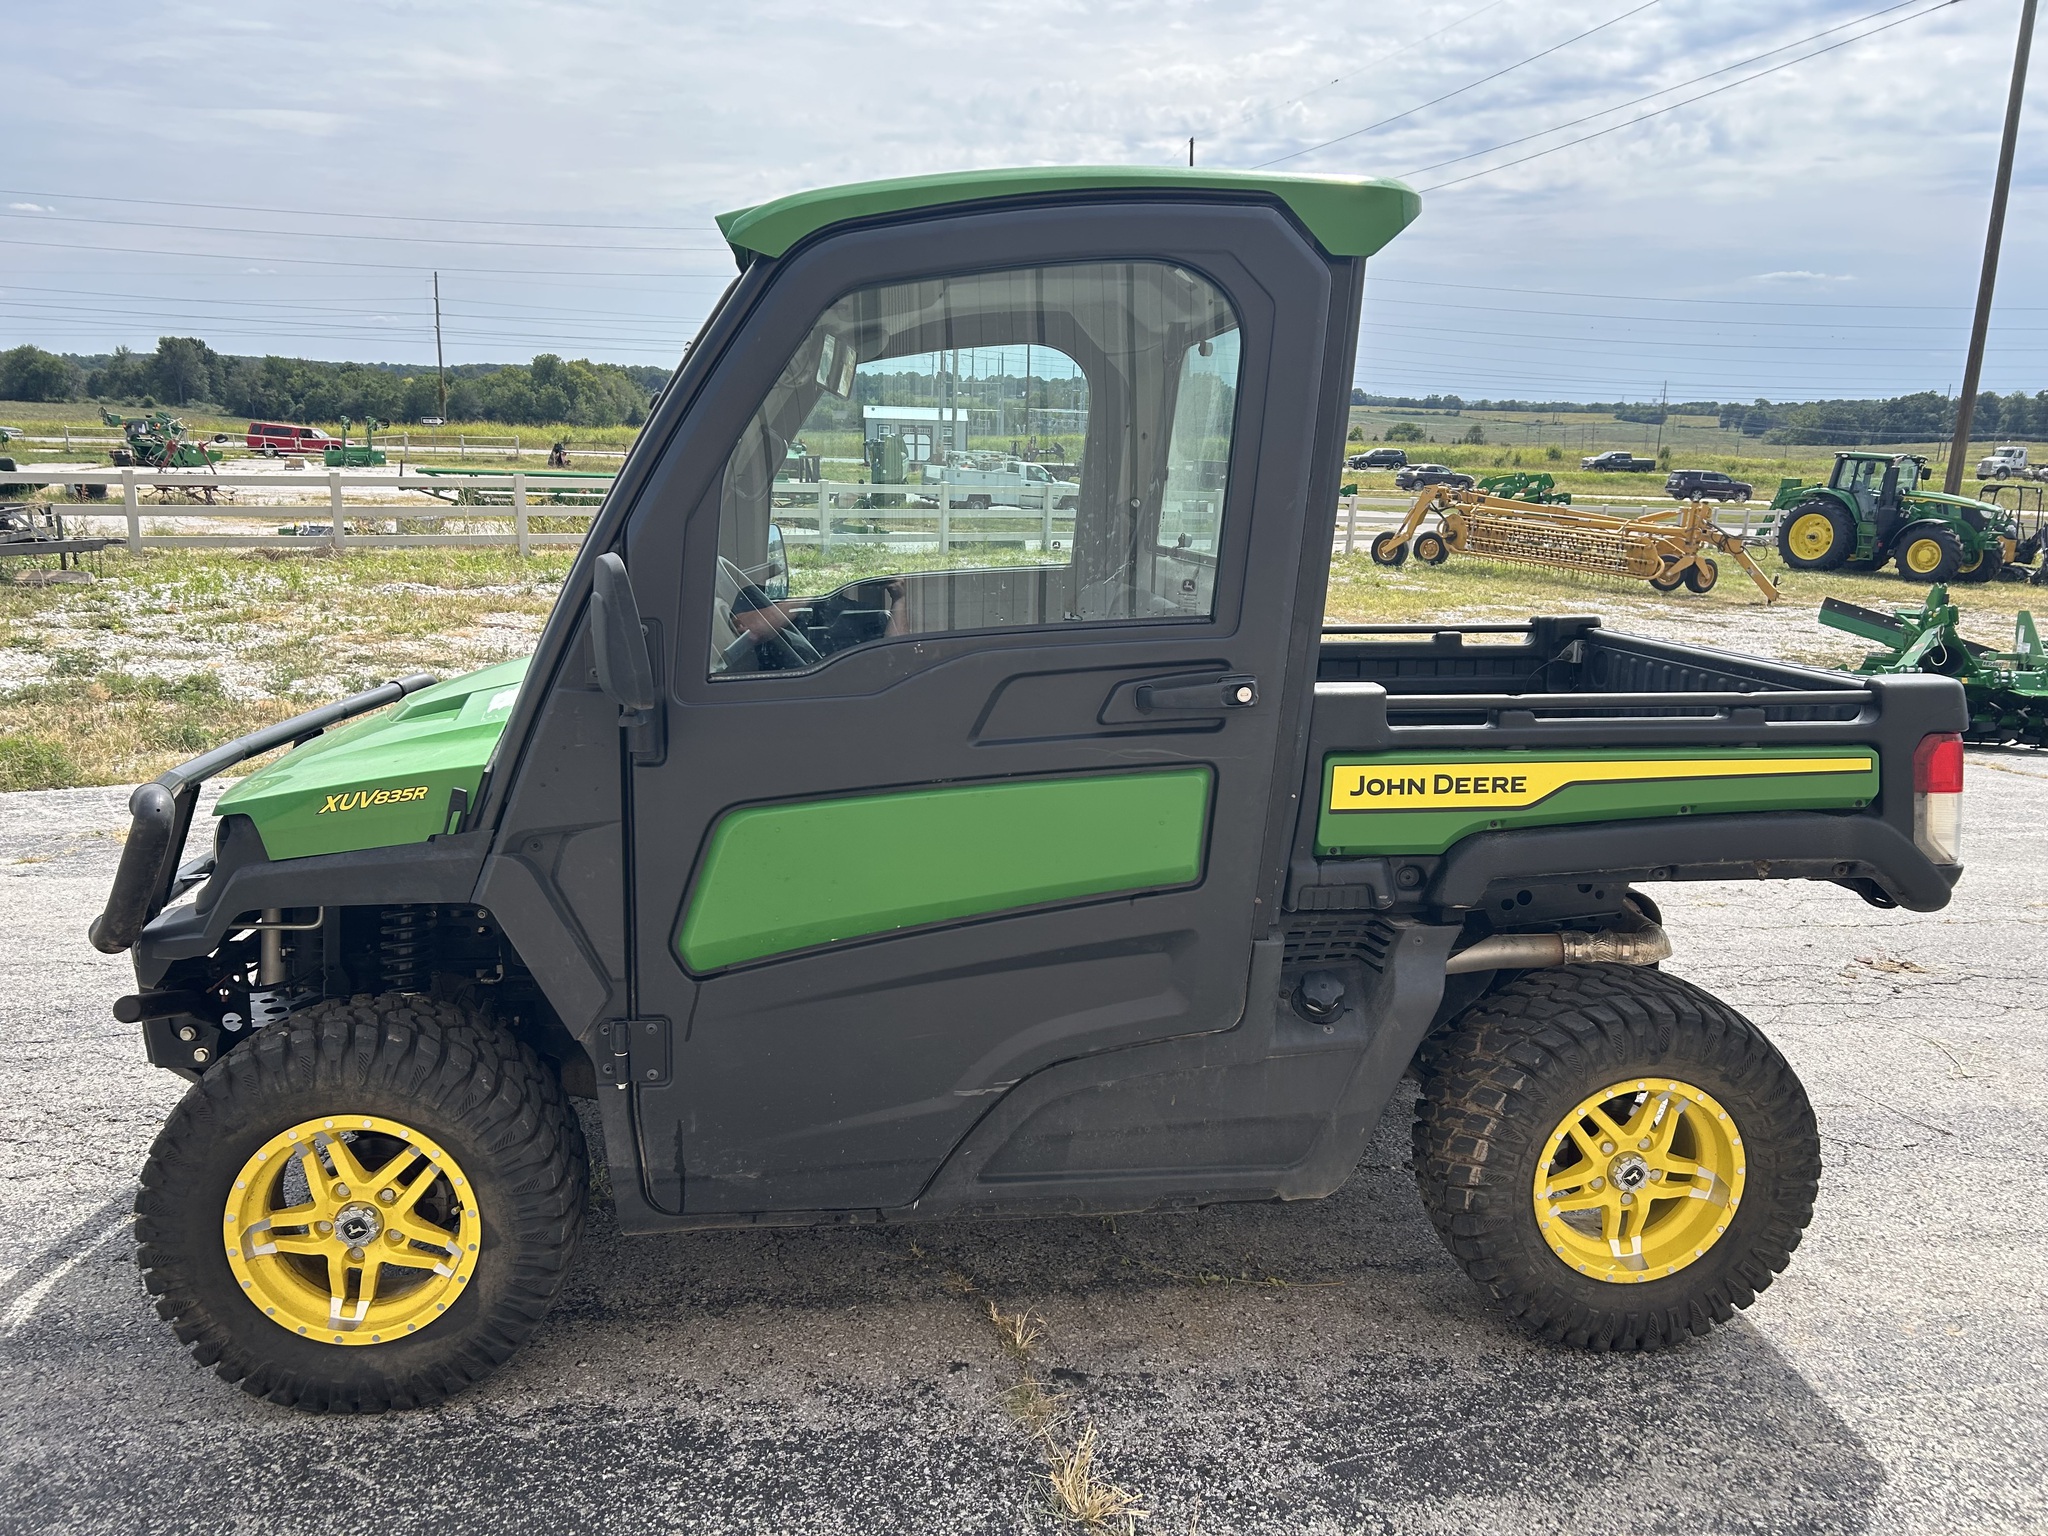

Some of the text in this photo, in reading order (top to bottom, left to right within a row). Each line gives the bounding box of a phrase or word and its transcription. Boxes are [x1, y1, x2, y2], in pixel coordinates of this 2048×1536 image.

[1350, 774, 1527, 796] JOHN DEERE
[317, 785, 429, 814] XUV835R
